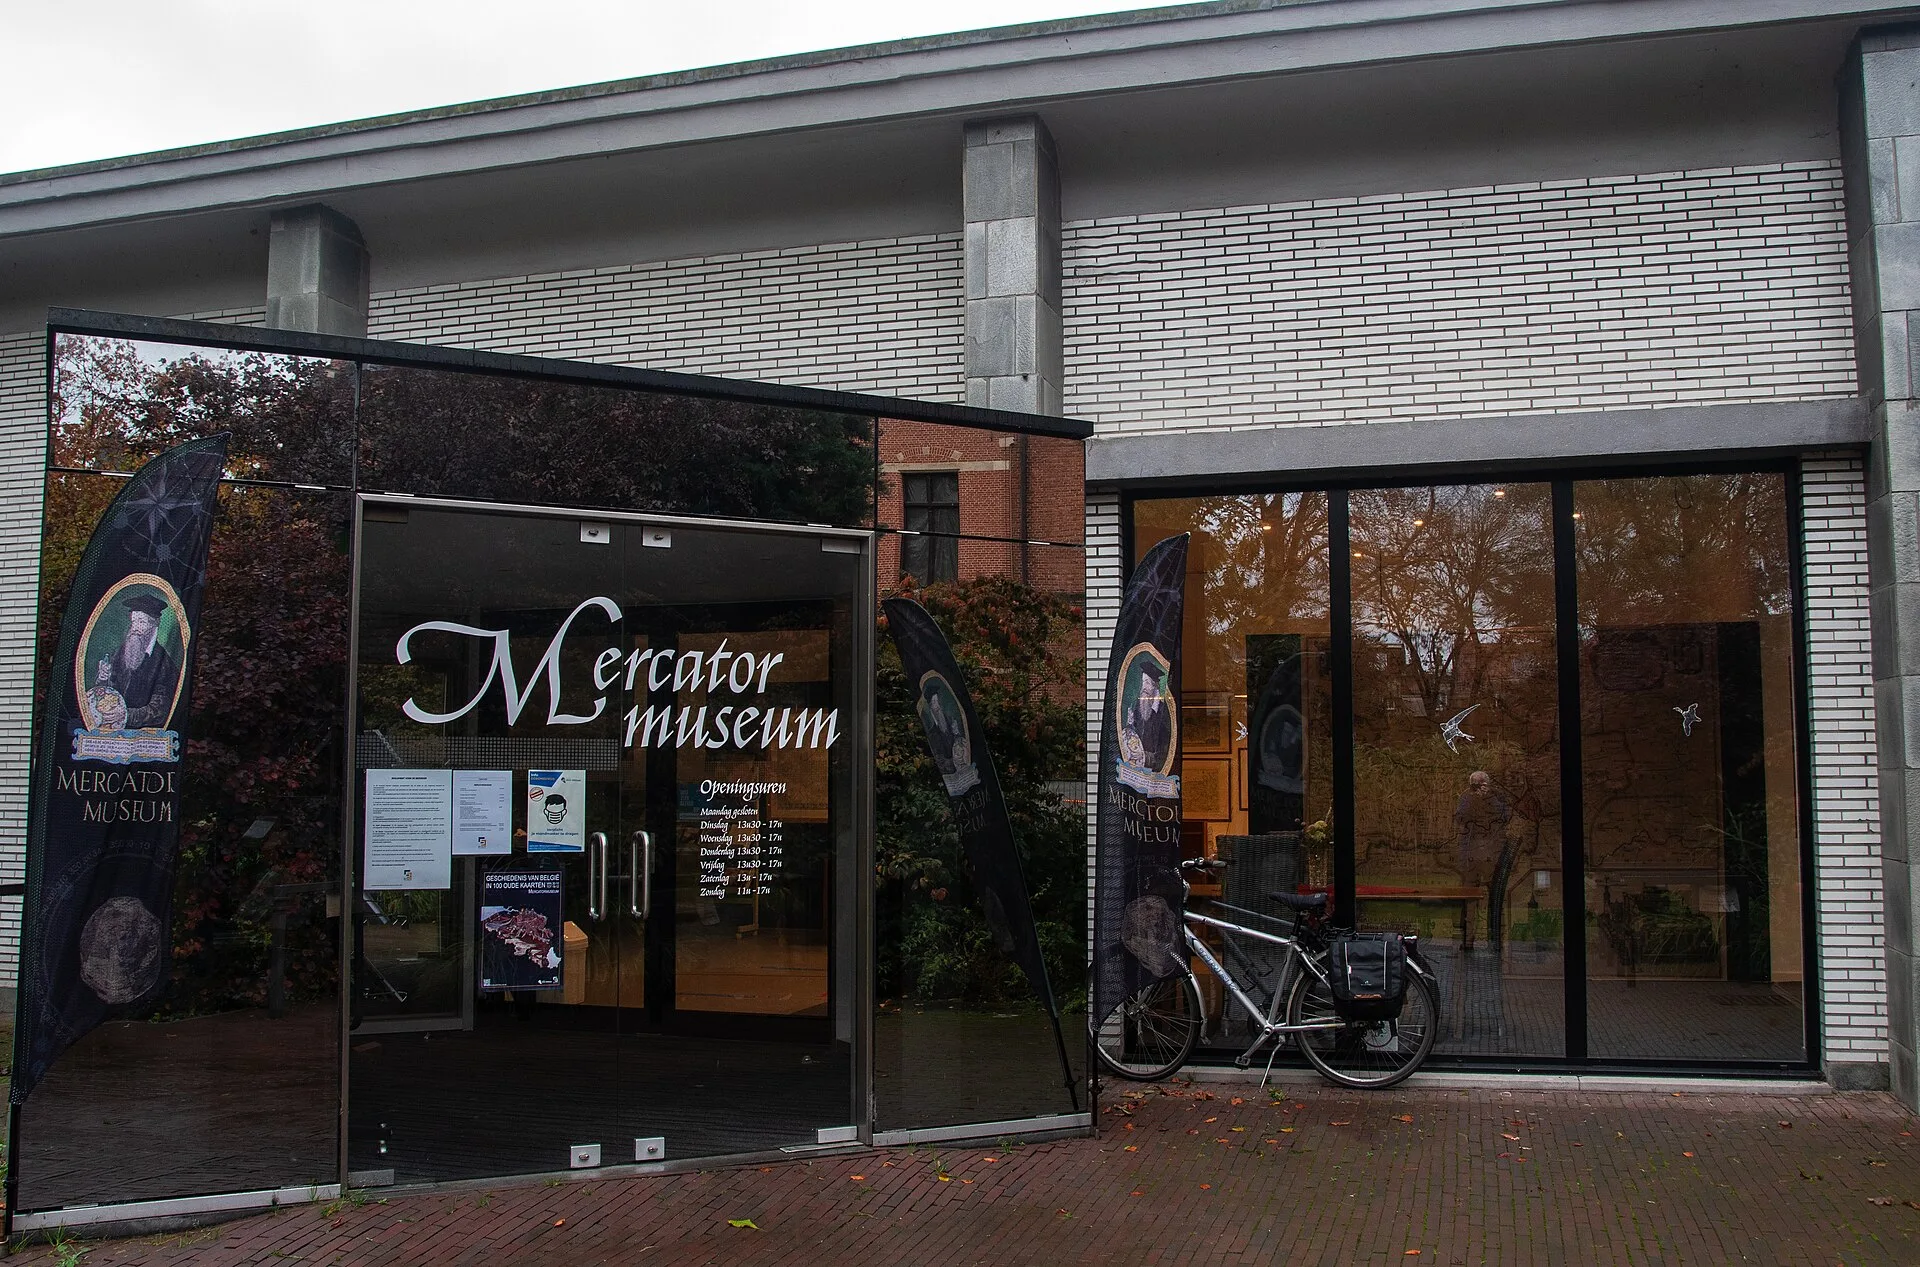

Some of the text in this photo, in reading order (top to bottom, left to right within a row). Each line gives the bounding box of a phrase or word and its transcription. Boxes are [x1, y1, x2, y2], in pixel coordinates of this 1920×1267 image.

[396, 596, 784, 727] Mercator
[622, 704, 841, 750] museum
[700, 778, 787, 802] Openingsuren
[700, 804, 759, 820] Maandag gesloten
[700, 818, 729, 833] Dinsdag
[737, 820, 761, 829] 13u30
[768, 820, 783, 829] 17u
[700, 831, 733, 846] Woensdag
[737, 833, 761, 842] 13u30
[768, 833, 783, 842] 17u
[700, 845, 735, 859] Donderdag
[737, 847, 761, 855] 13u30
[768, 846, 783, 855] 17u
[700, 858, 725, 873] Vrijdag
[737, 860, 761, 869] 13u30
[768, 859, 783, 868] 17u
[700, 872, 730, 886] Zaterdag
[737, 873, 751, 882] 13u
[758, 873, 773, 881] 17u
[700, 885, 726, 900] Zondag
[737, 887, 751, 895] 11u
